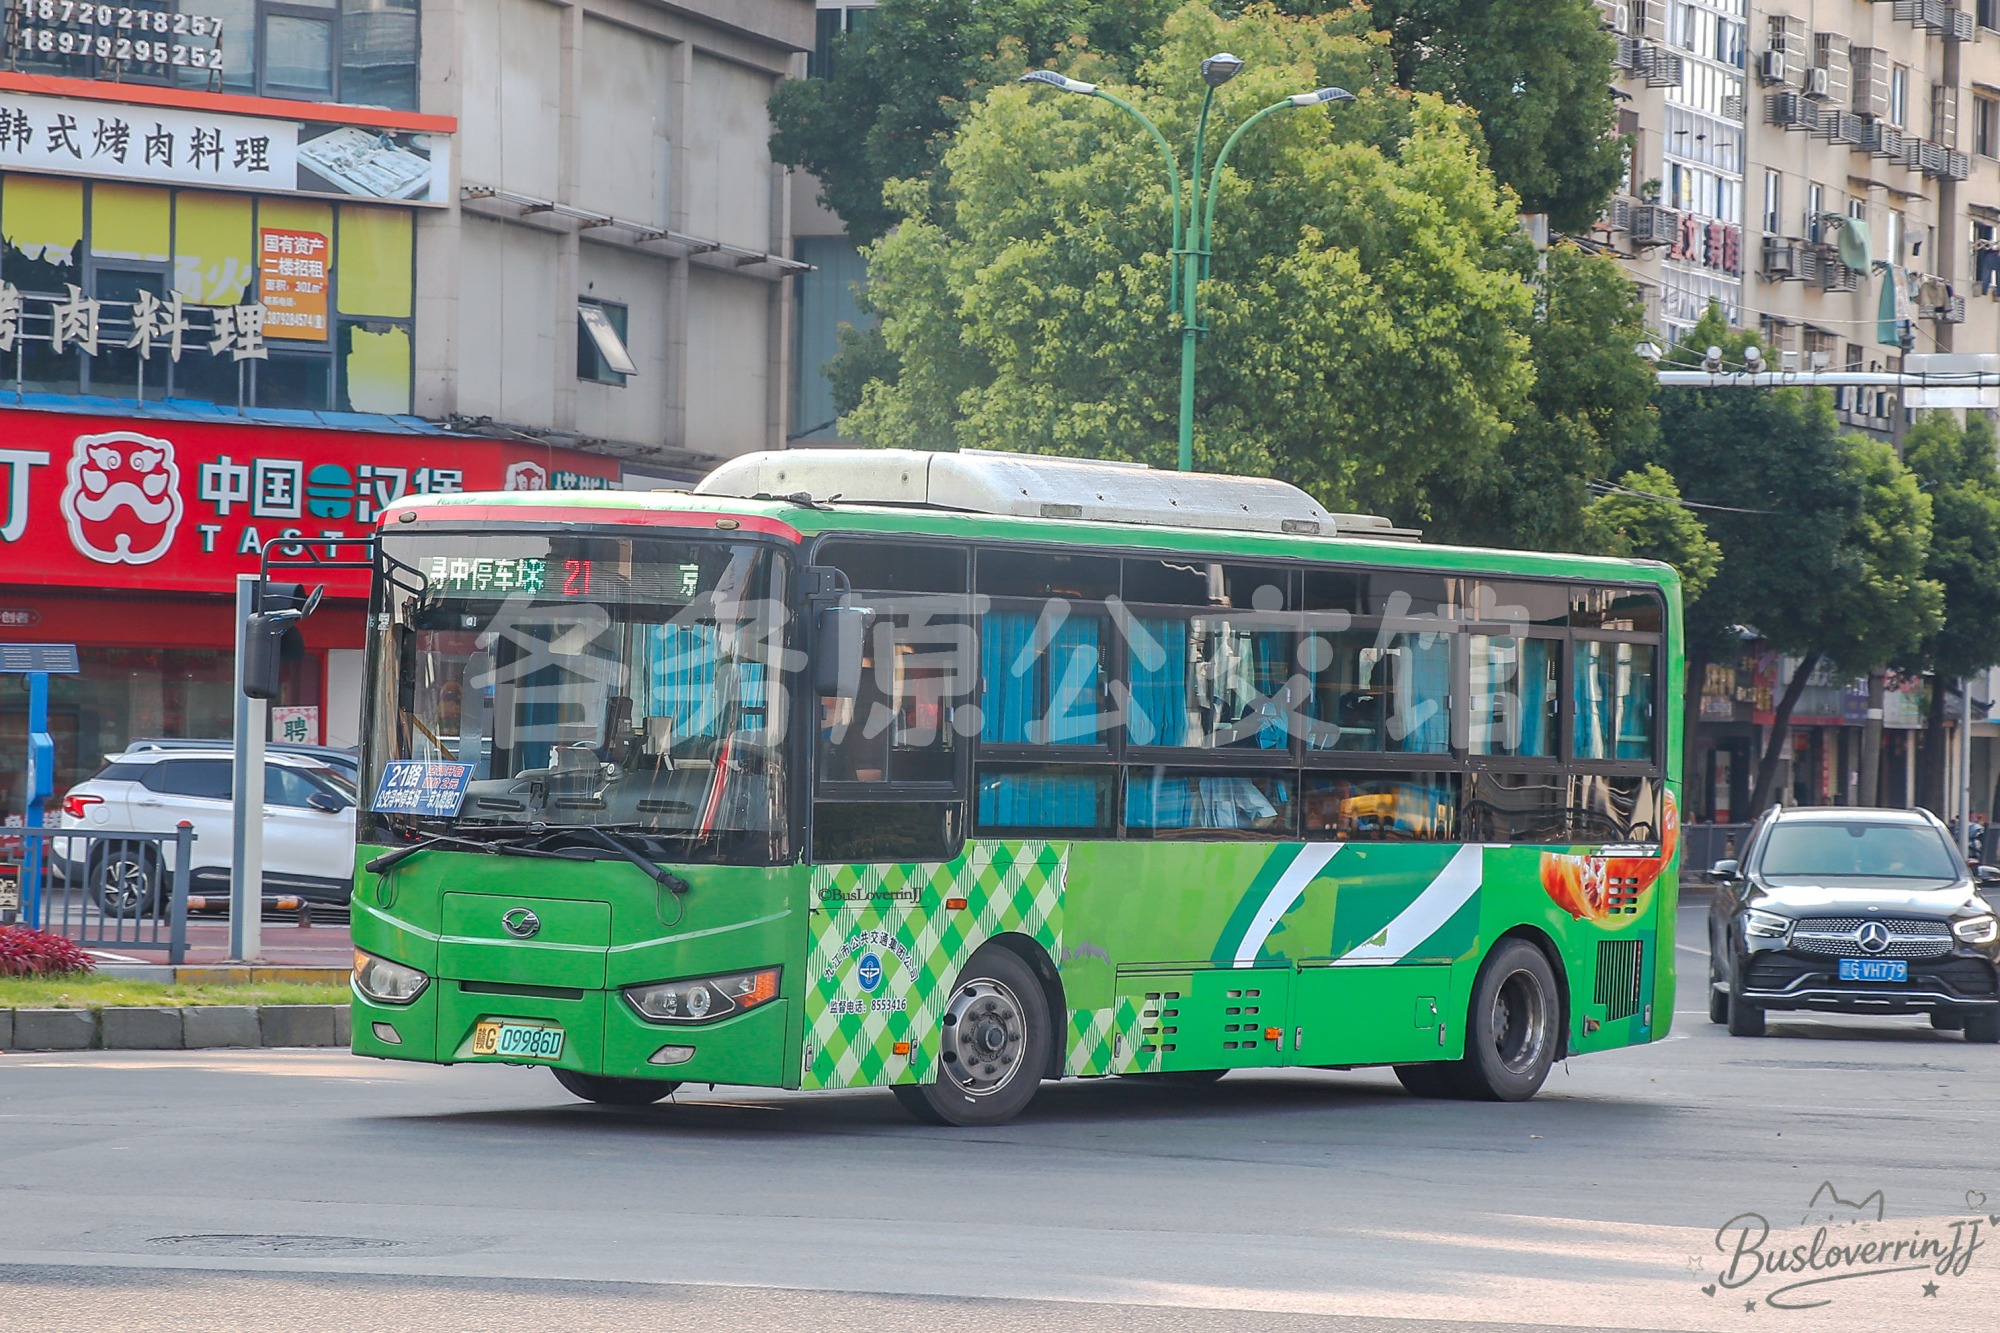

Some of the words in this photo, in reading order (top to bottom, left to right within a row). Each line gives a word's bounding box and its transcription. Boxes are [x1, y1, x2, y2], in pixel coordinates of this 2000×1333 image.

[22, 0, 223, 38] 18720218257
[20, 28, 223, 70] 18979295252
[0, 107, 271, 173] 韩式烤肉料理
[263, 234, 324, 255] 国有资产
[264, 257, 324, 278] 二楼招租
[562, 560, 592, 596] 21
[284, 716, 307, 742] 聘
[387, 764, 424, 788] 21路
[825, 930, 918, 983] 九江市公共交通集团公司
[870, 999, 907, 1011] 8553416
